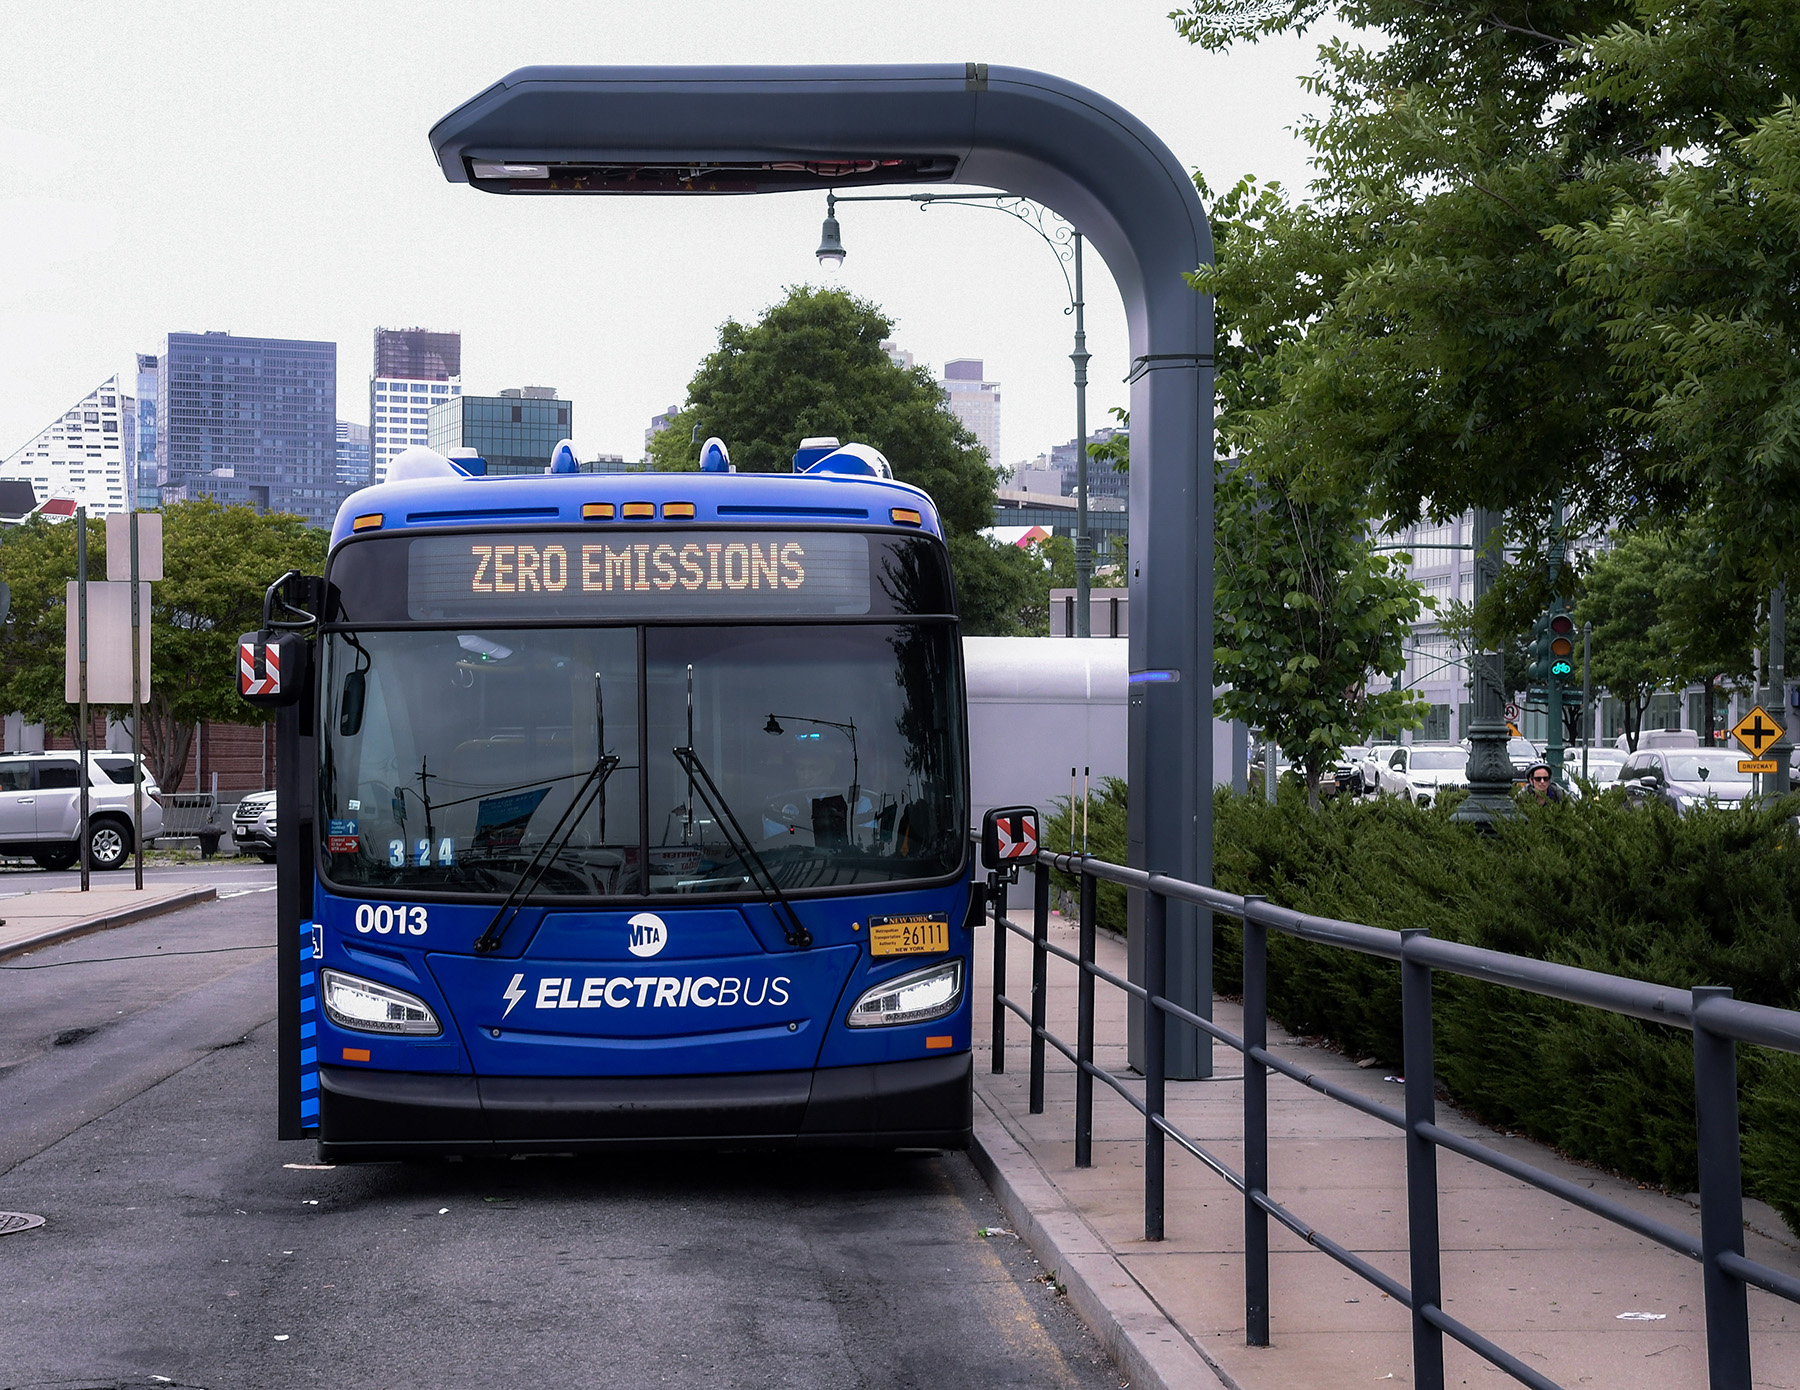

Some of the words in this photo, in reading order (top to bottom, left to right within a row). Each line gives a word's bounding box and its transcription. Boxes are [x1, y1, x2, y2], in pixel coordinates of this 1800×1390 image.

[472, 545, 567, 592] ZERO
[582, 542, 805, 591] EMISSIONS
[355, 904, 428, 936] 0013
[889, 917, 907, 925] NEW
[910, 915, 929, 923] YORK
